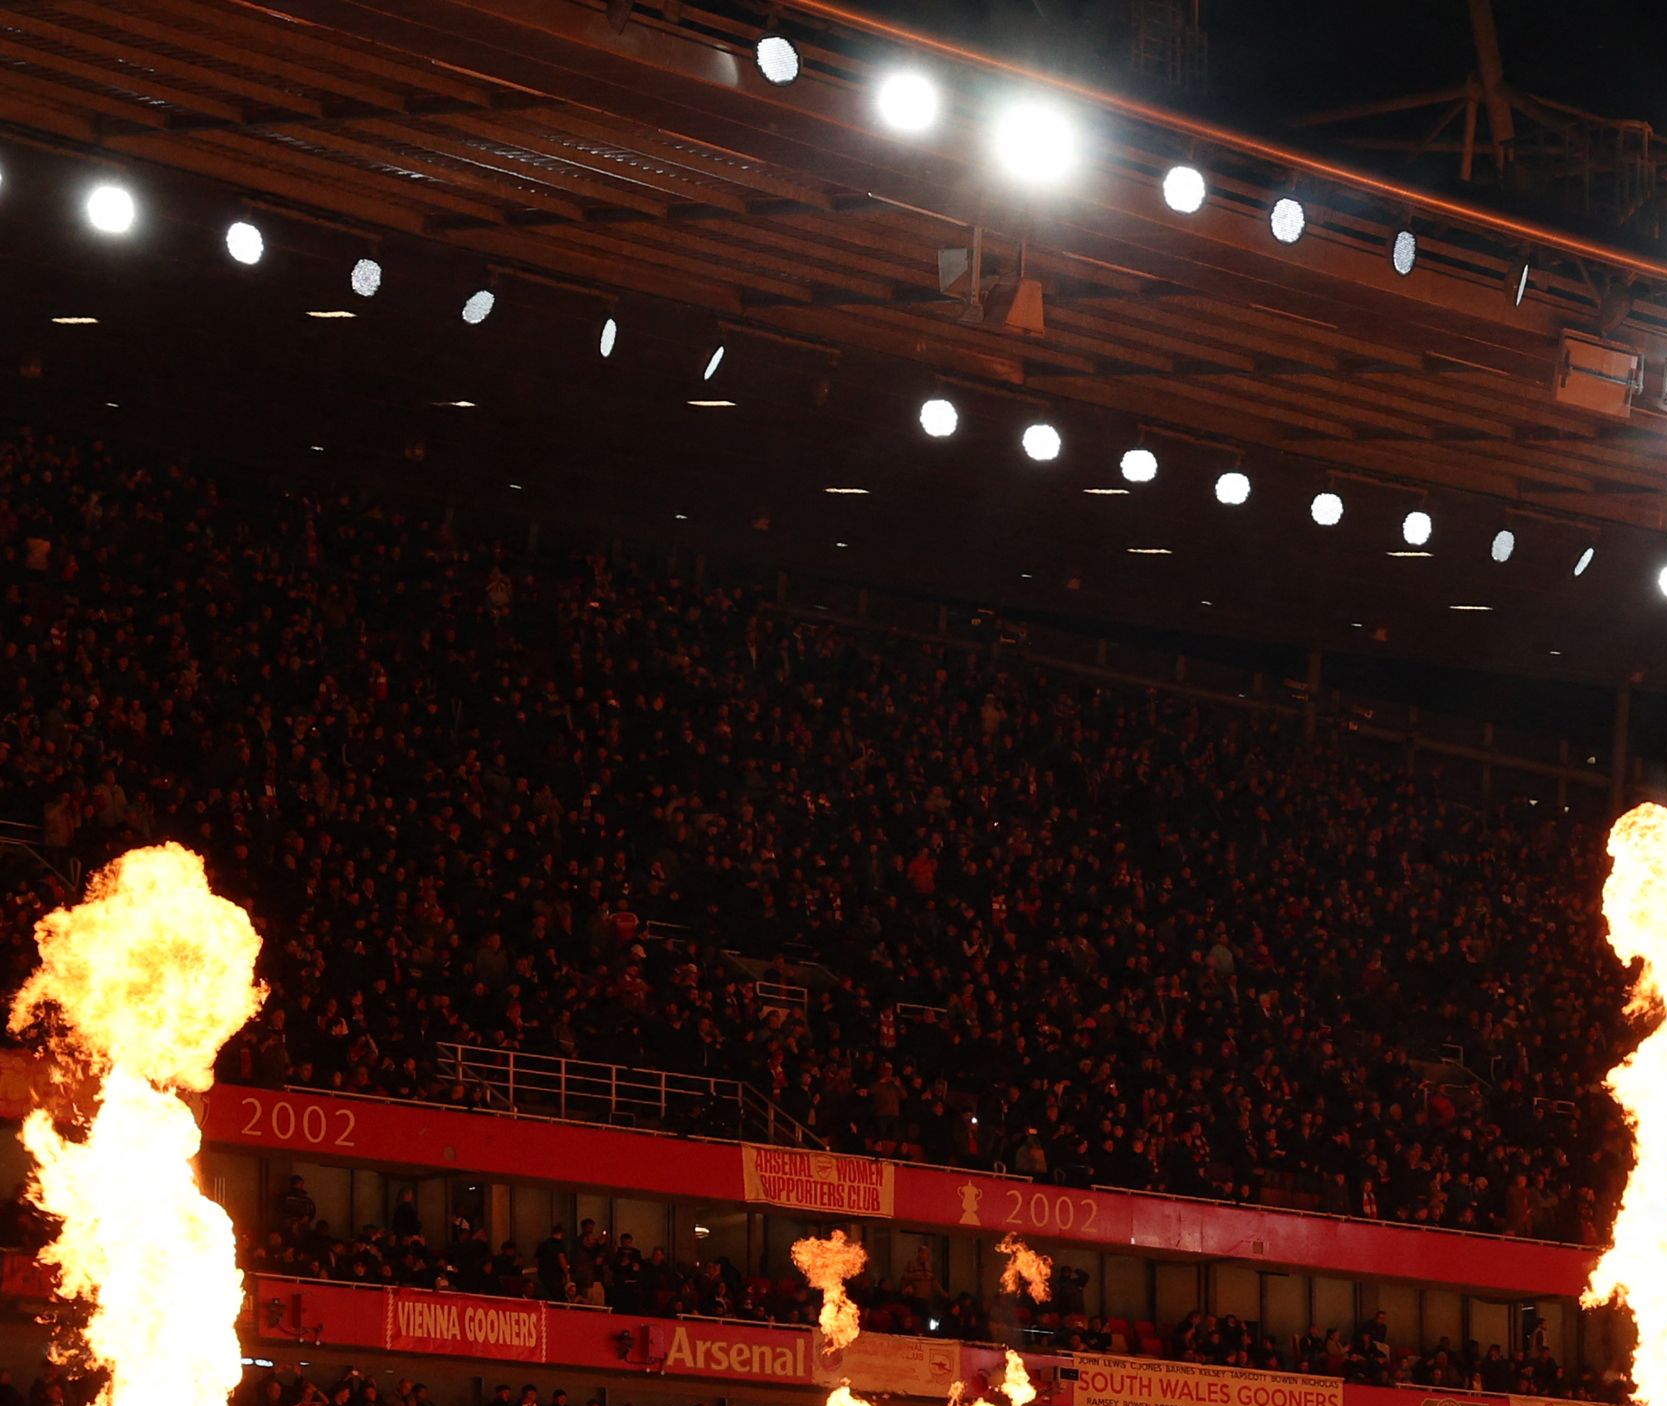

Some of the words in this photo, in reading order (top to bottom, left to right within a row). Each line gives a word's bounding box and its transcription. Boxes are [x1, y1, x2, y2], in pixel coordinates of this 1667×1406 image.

[241, 1098, 355, 1147] 2002
[755, 1150, 813, 1178] ARSENAL
[836, 1158, 883, 1187] WOMEN
[760, 1174, 844, 1208] SUPPORTERS
[848, 1186, 880, 1212] CLUB
[1006, 1190, 1099, 1233] 2002
[399, 1300, 461, 1341] VIENNA
[464, 1306, 537, 1348] GOONERS
[666, 1326, 805, 1377] Arsenal
[1078, 1358, 1099, 1366] JOHN
[1104, 1360, 1126, 1368] LEWIS
[1166, 1365, 1195, 1375] BARNES
[1270, 1375, 1298, 1384] BOWEN
[1302, 1378, 1339, 1389] NICHOLAS
[1078, 1370, 1152, 1397] SOUTH
[1160, 1379, 1230, 1404] WALES
